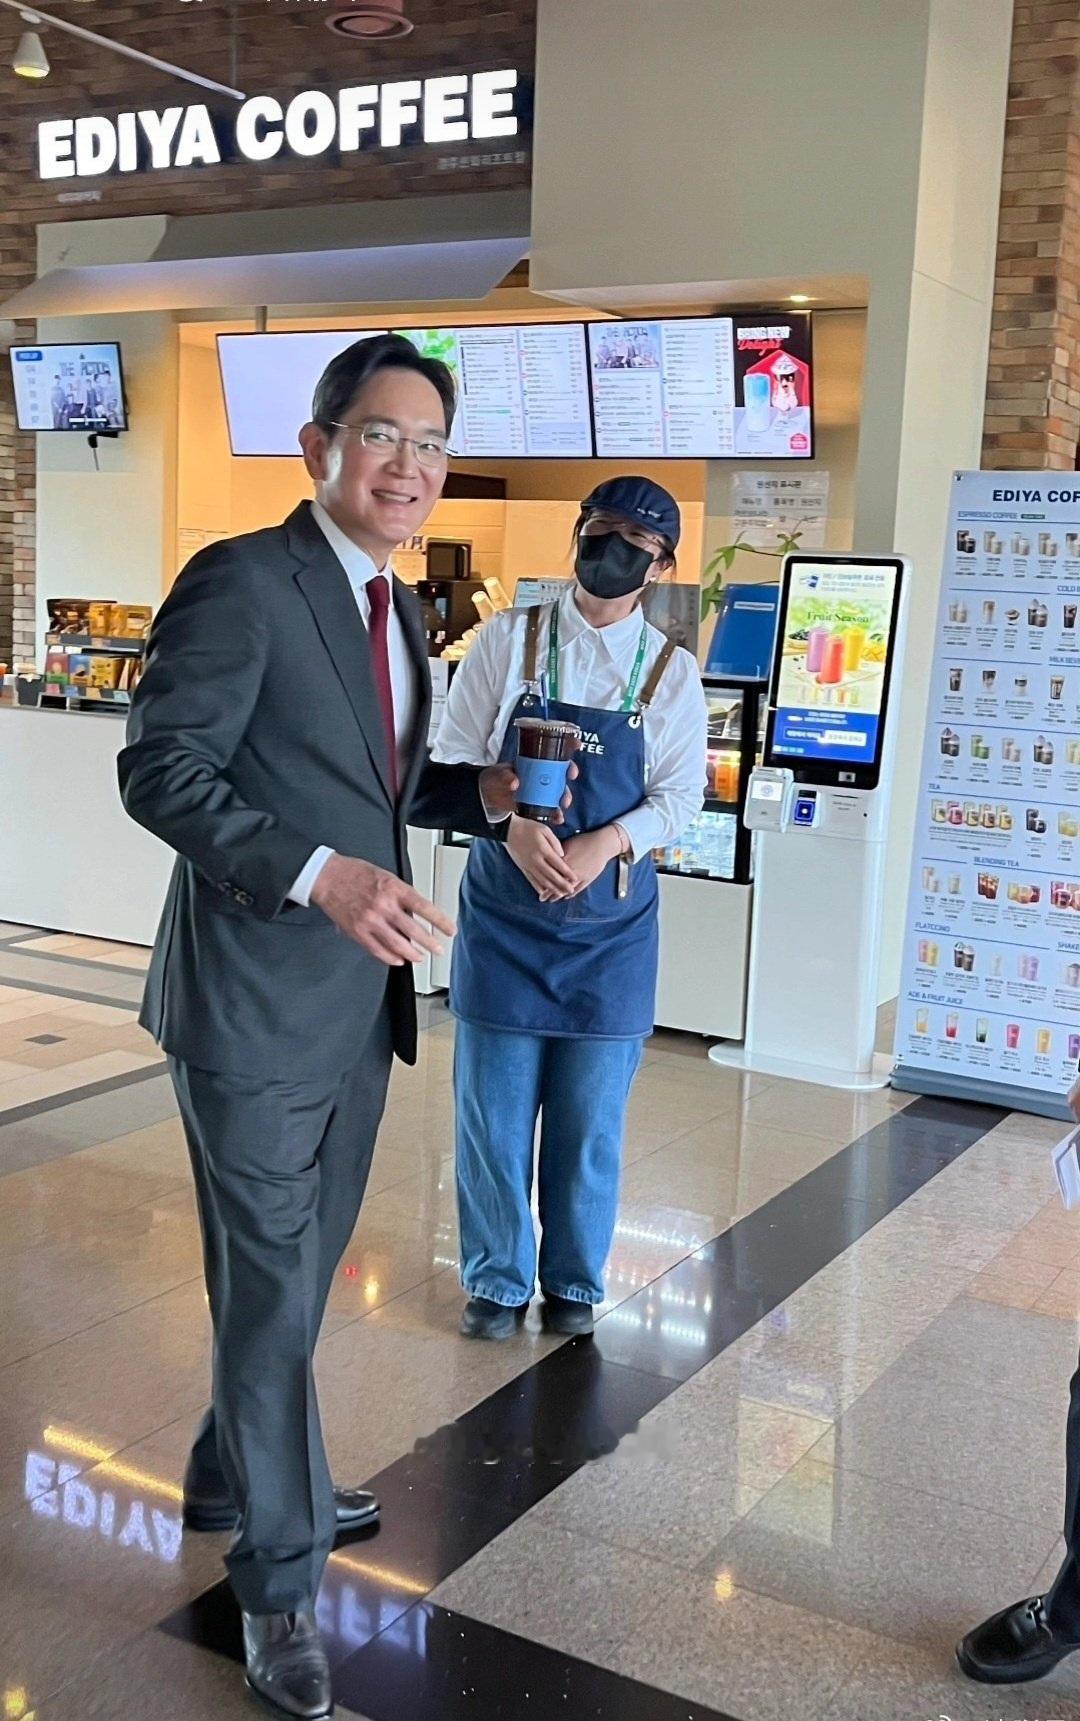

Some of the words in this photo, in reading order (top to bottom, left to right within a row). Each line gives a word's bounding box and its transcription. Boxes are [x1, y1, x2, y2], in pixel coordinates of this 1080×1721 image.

[38, 105, 221, 179] EDIYA
[236, 69, 518, 161] COFFEE
[993, 489, 1042, 502] EDIYA
[993, 511, 1018, 519] COFFEE
[574, 730, 599, 743] IYA
[974, 857, 1006, 866] BLENDING
